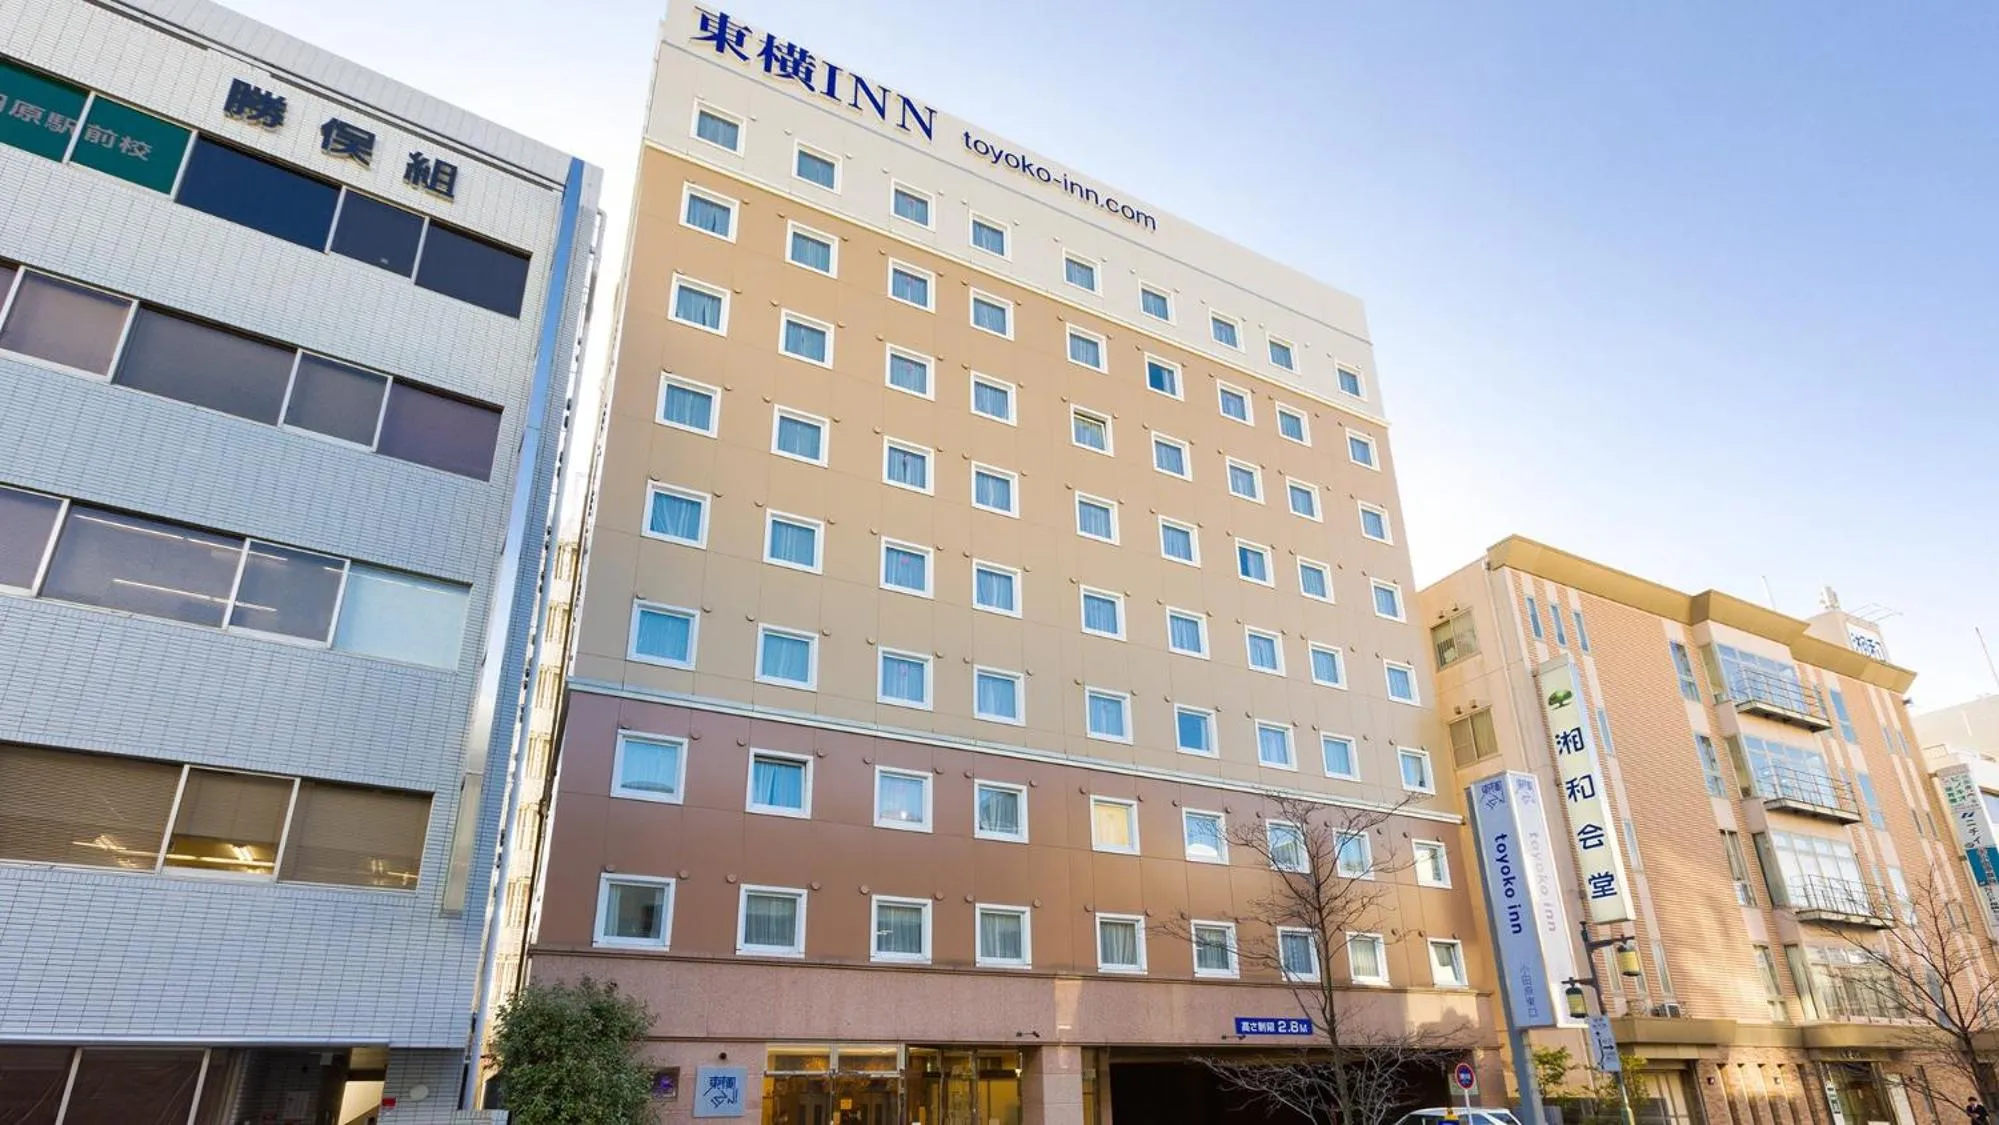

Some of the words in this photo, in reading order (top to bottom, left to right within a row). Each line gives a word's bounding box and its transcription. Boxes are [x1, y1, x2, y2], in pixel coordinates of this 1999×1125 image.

[690, 6, 938, 141] 東横INN
[223, 77, 458, 201] 勝俣組
[963, 131, 1157, 232] toyoko-inn.com
[1555, 726, 1618, 900] 湘和会堂
[1494, 832, 1516, 898] toyoko
[1507, 904, 1523, 934] inn
[1529, 832, 1550, 896] toyoko
[1544, 902, 1557, 933] inn
